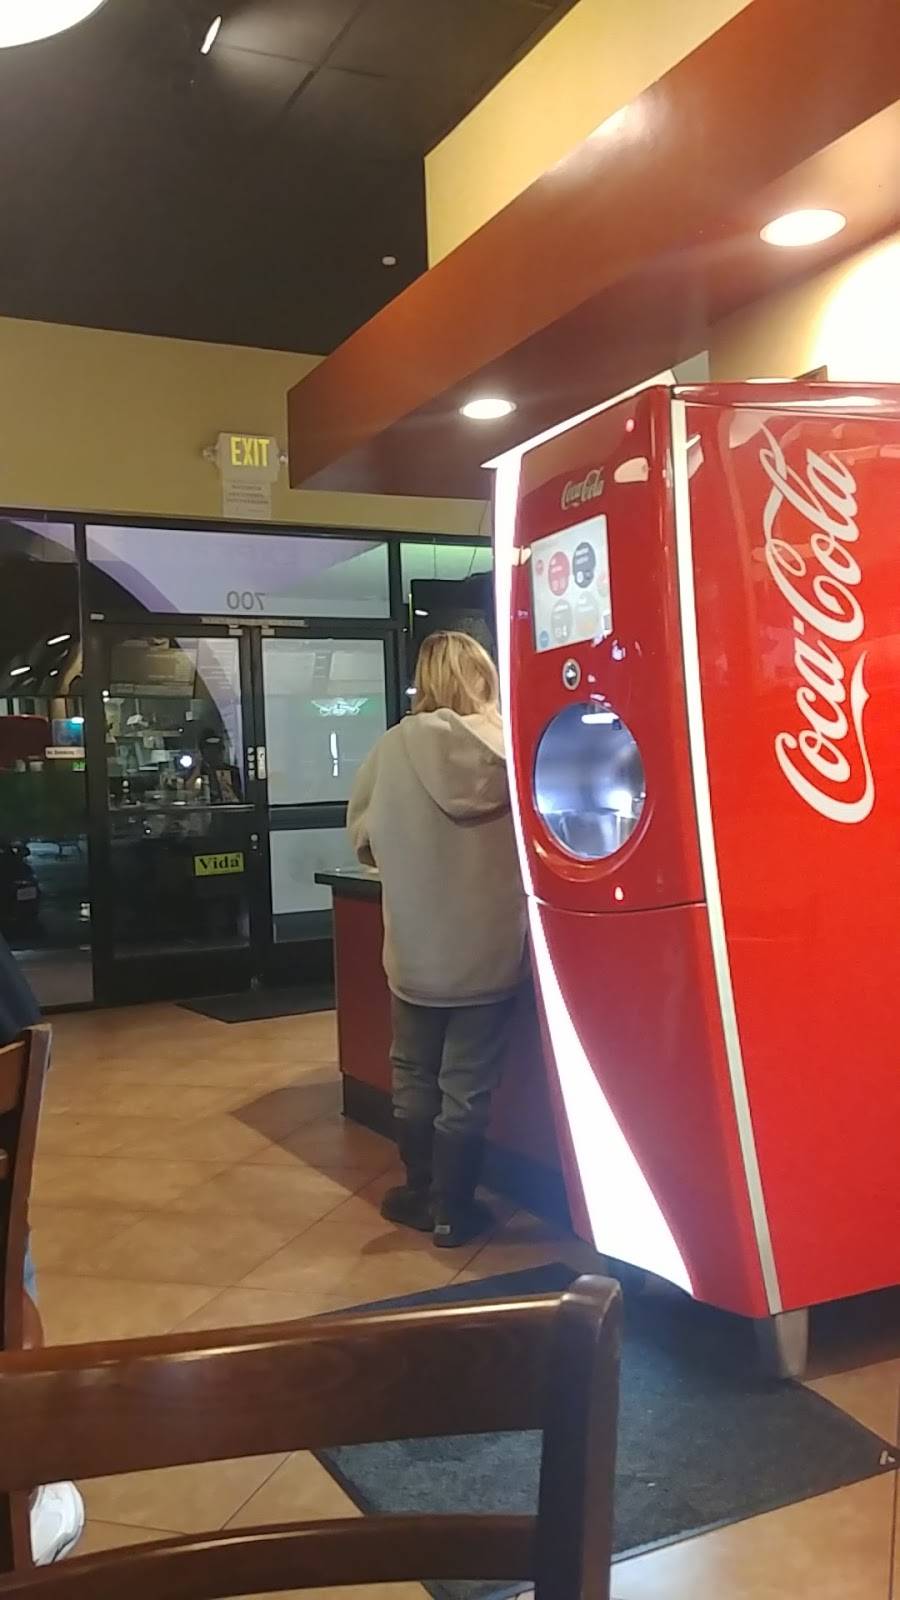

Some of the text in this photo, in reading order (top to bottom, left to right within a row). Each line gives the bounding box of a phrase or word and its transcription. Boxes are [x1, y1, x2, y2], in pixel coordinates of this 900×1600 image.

[230, 436, 270, 467] EXIT
[759, 422, 876, 825] Coca-Cola
[199, 855, 241, 870] Vida
